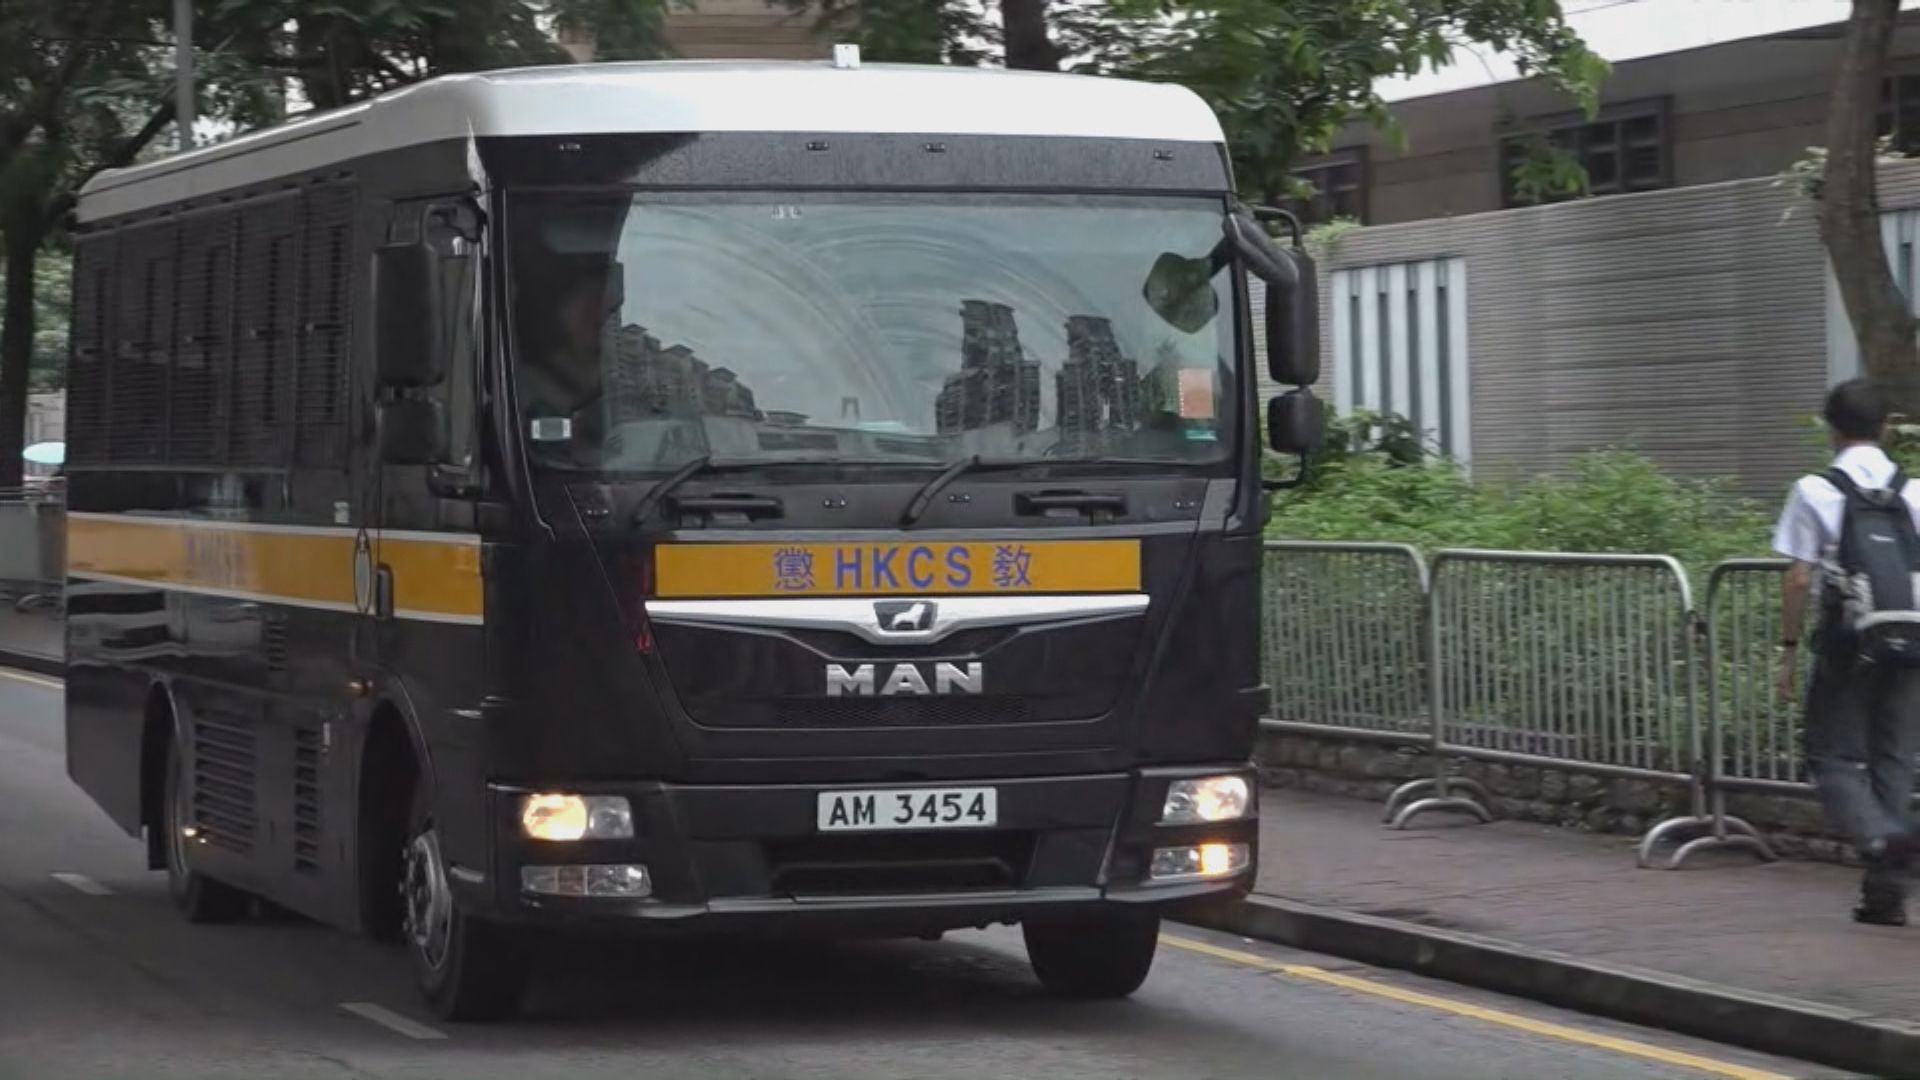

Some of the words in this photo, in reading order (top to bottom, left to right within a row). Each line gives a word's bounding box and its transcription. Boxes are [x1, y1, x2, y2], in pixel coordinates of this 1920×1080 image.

[837, 546, 973, 590] HKCS
[826, 662, 984, 697] MAN
[828, 795, 876, 826] AM
[893, 792, 987, 824] 3454
